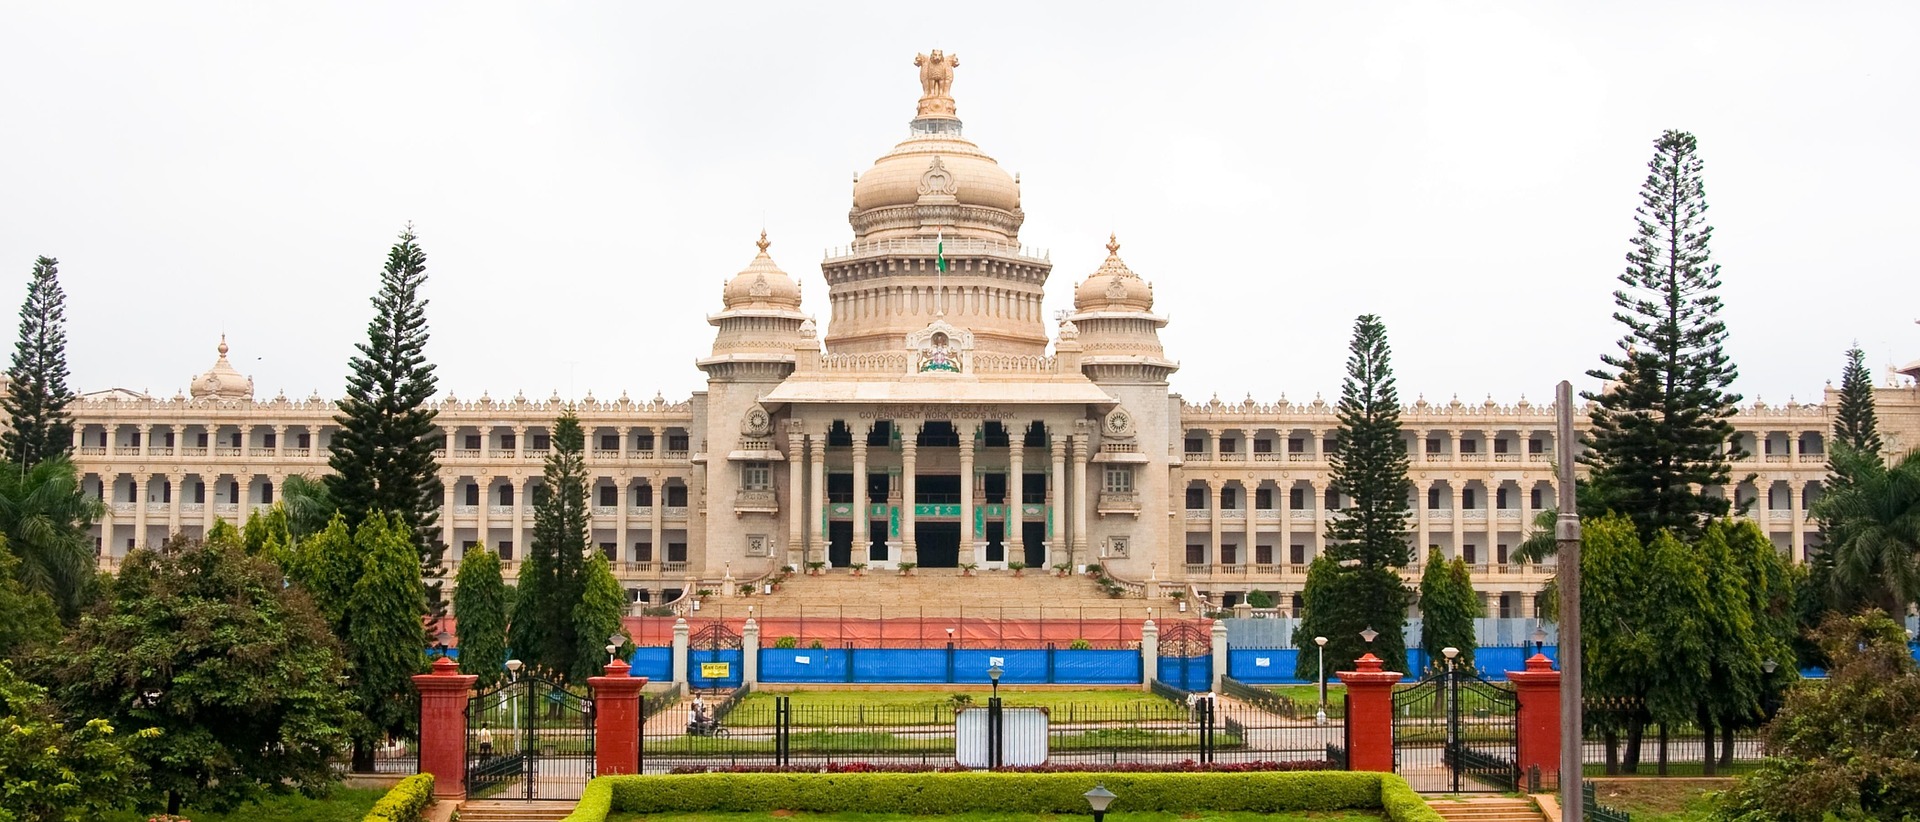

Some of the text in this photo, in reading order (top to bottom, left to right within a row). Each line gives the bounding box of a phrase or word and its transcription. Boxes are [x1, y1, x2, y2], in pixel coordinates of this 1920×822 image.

[859, 411, 921, 419] GOVERNMENT
[924, 411, 949, 419] WORK
[951, 411, 960, 419] IS
[990, 411, 1018, 419] WORK.
